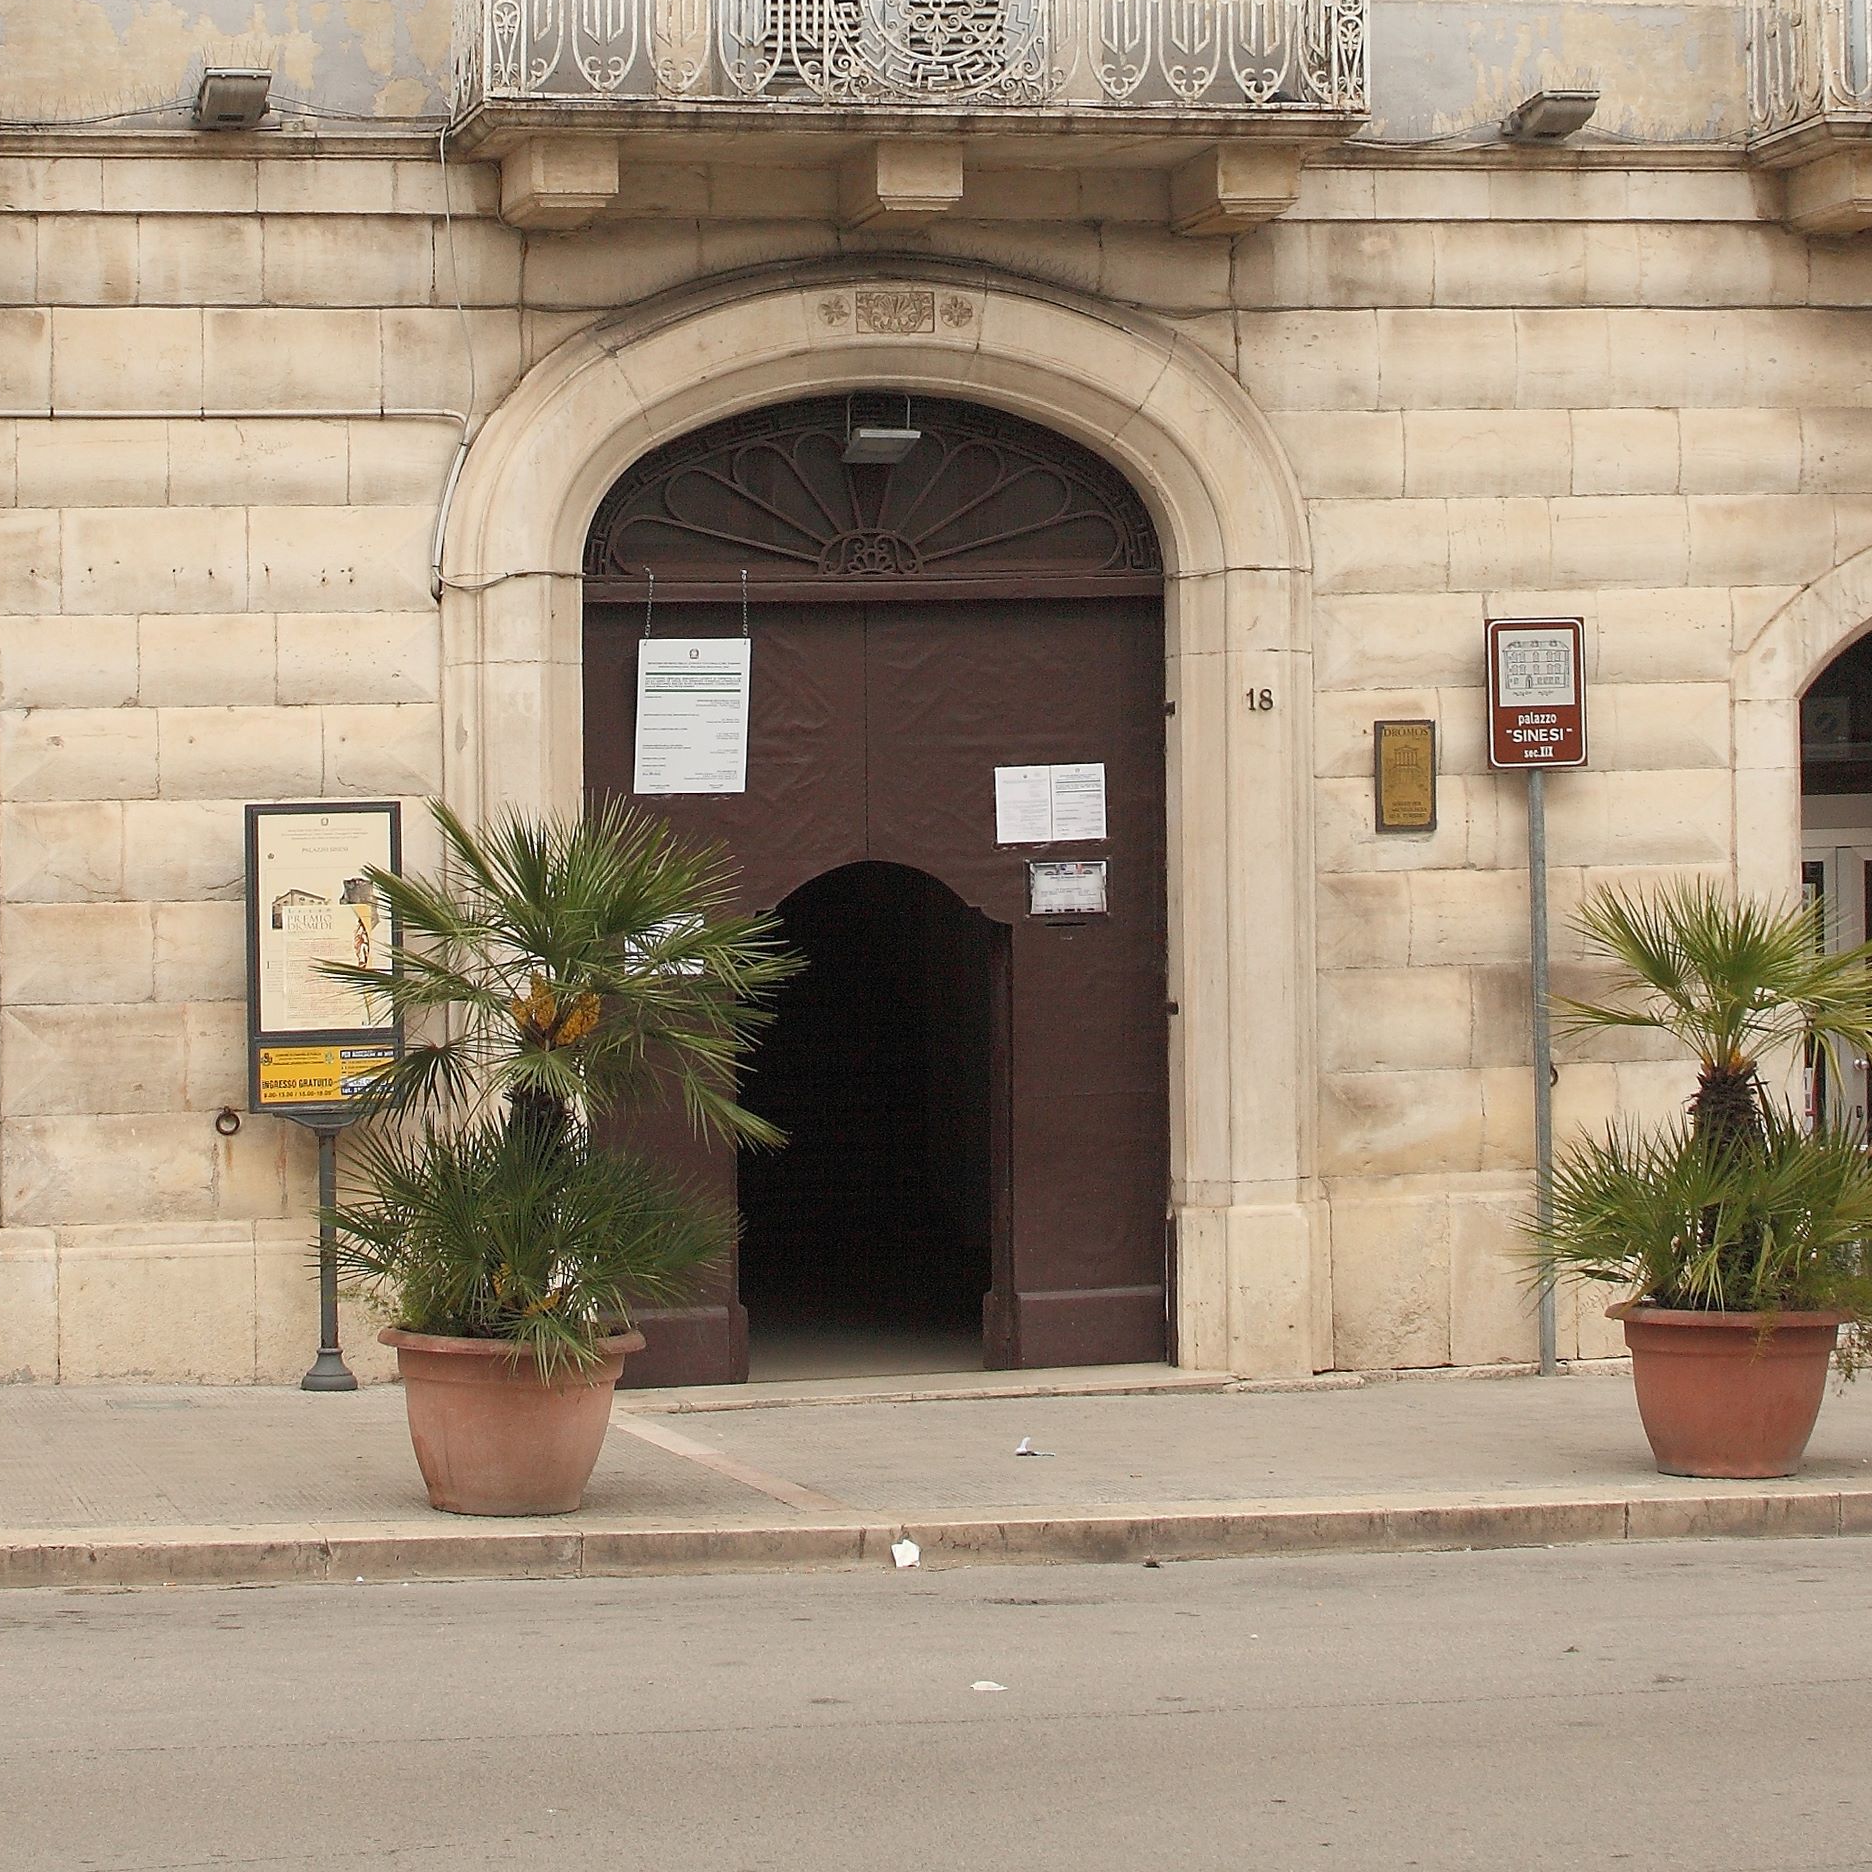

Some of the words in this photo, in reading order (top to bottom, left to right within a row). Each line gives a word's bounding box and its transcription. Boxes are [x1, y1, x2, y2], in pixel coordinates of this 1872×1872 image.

[1246, 687, 1274, 711] 18
[1518, 711, 1557, 726] palazzo
[1383, 728, 1429, 737] DROMOS
[261, 1079, 297, 1090] INGRESSO
[298, 1077, 334, 1089] GRATUITO
